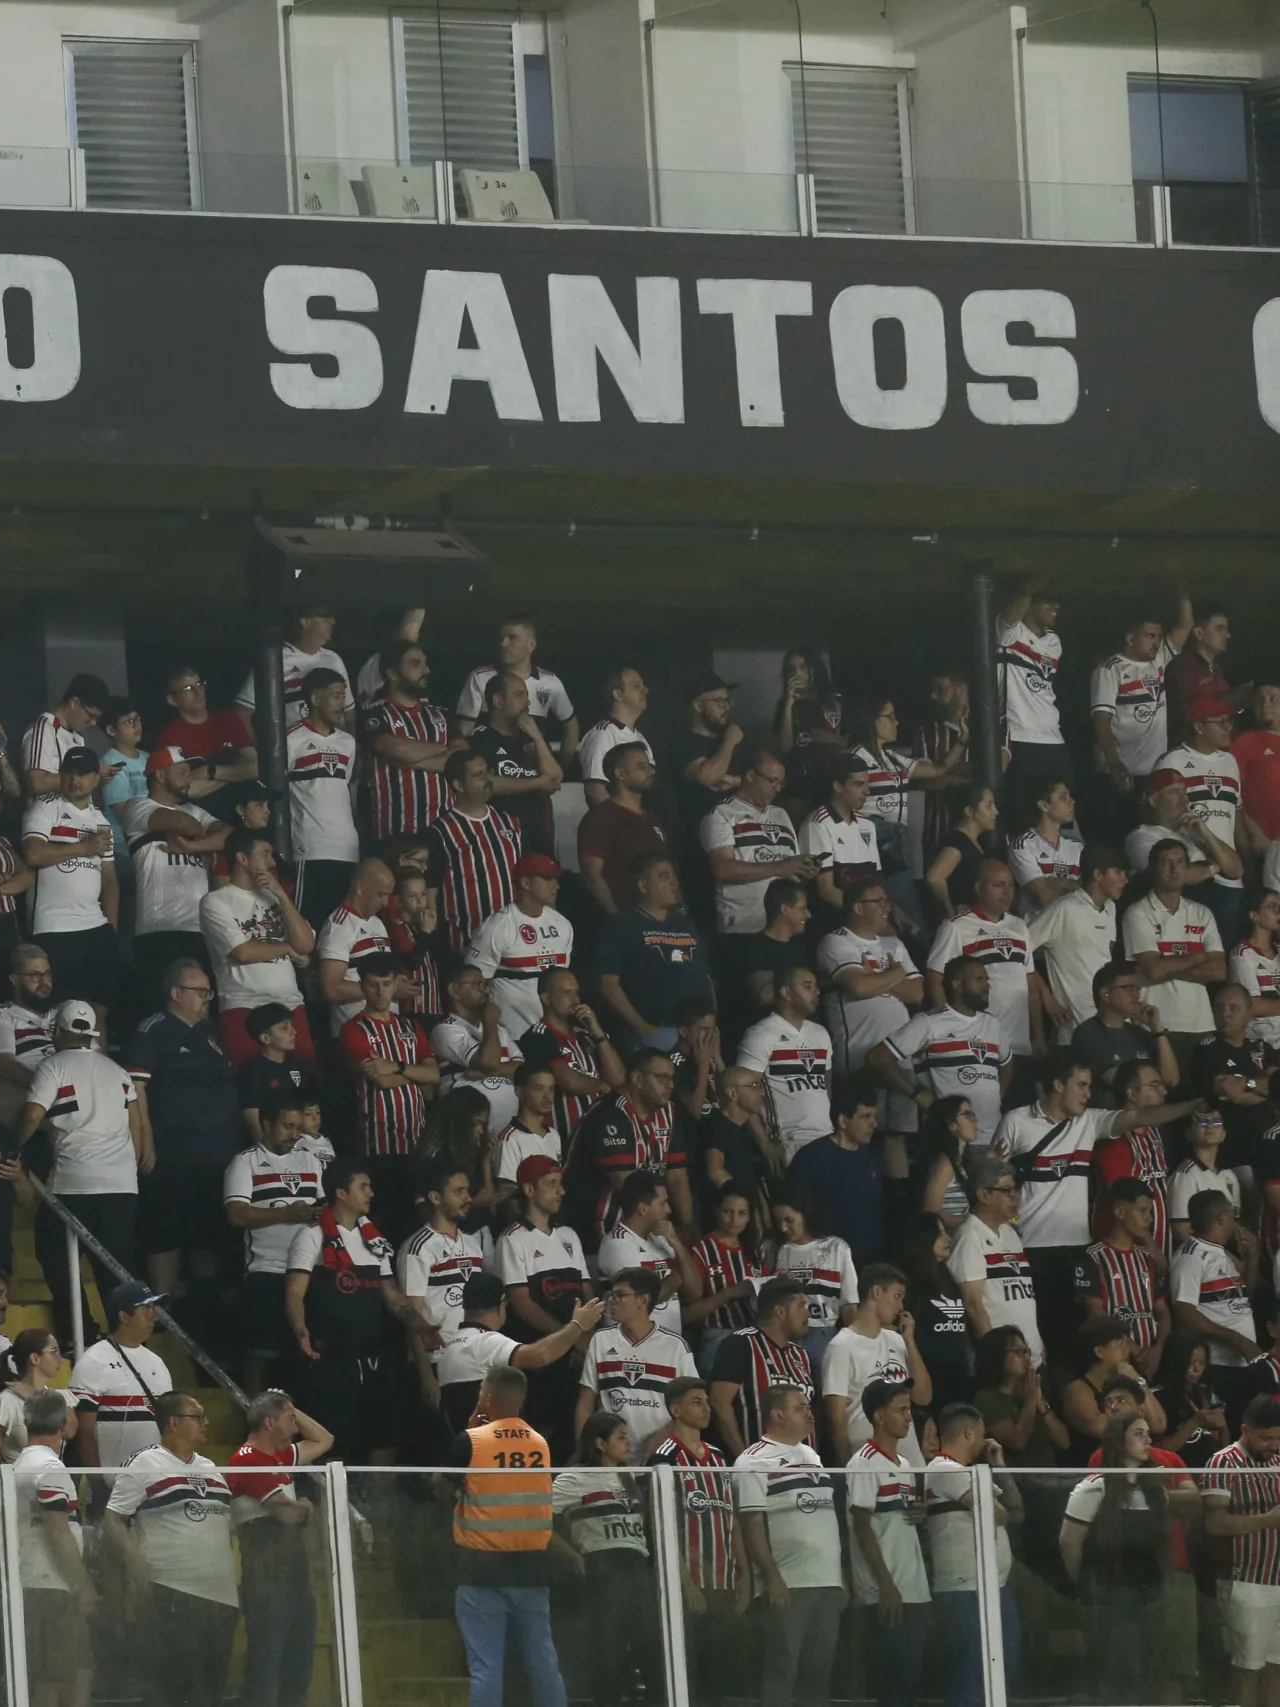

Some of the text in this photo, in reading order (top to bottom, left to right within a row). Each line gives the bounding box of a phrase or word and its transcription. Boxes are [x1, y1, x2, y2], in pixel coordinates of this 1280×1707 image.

[263, 264, 1079, 430] SANTOS
[540, 925, 558, 938] LG
[787, 1075, 826, 1092] inte
[604, 1137, 626, 1147] Bitso
[494, 1429, 532, 1439] STAFF
[493, 1451, 544, 1468] 182
[603, 1518, 643, 1540] inte
